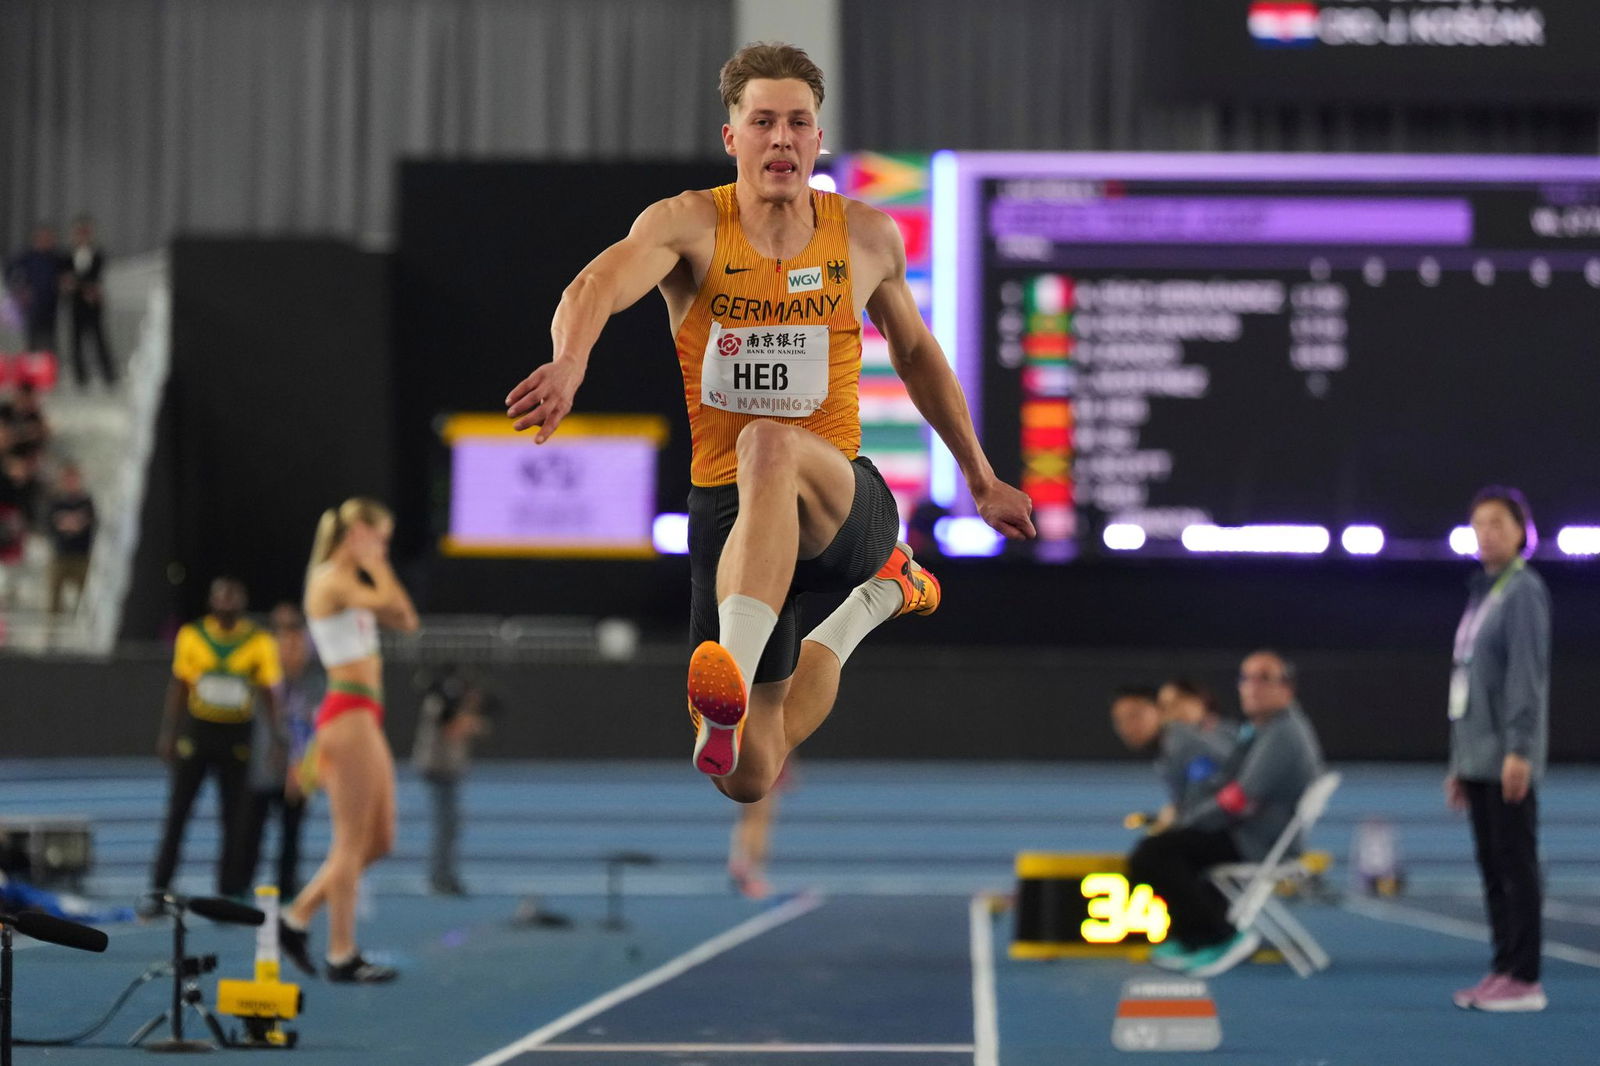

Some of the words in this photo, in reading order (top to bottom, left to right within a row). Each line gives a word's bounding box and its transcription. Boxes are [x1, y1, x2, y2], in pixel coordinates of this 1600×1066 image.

[789, 273, 821, 287] WGV
[711, 294, 842, 323] GERMANY
[746, 332, 807, 348] 南京银行
[1081, 873, 1171, 943] 34
